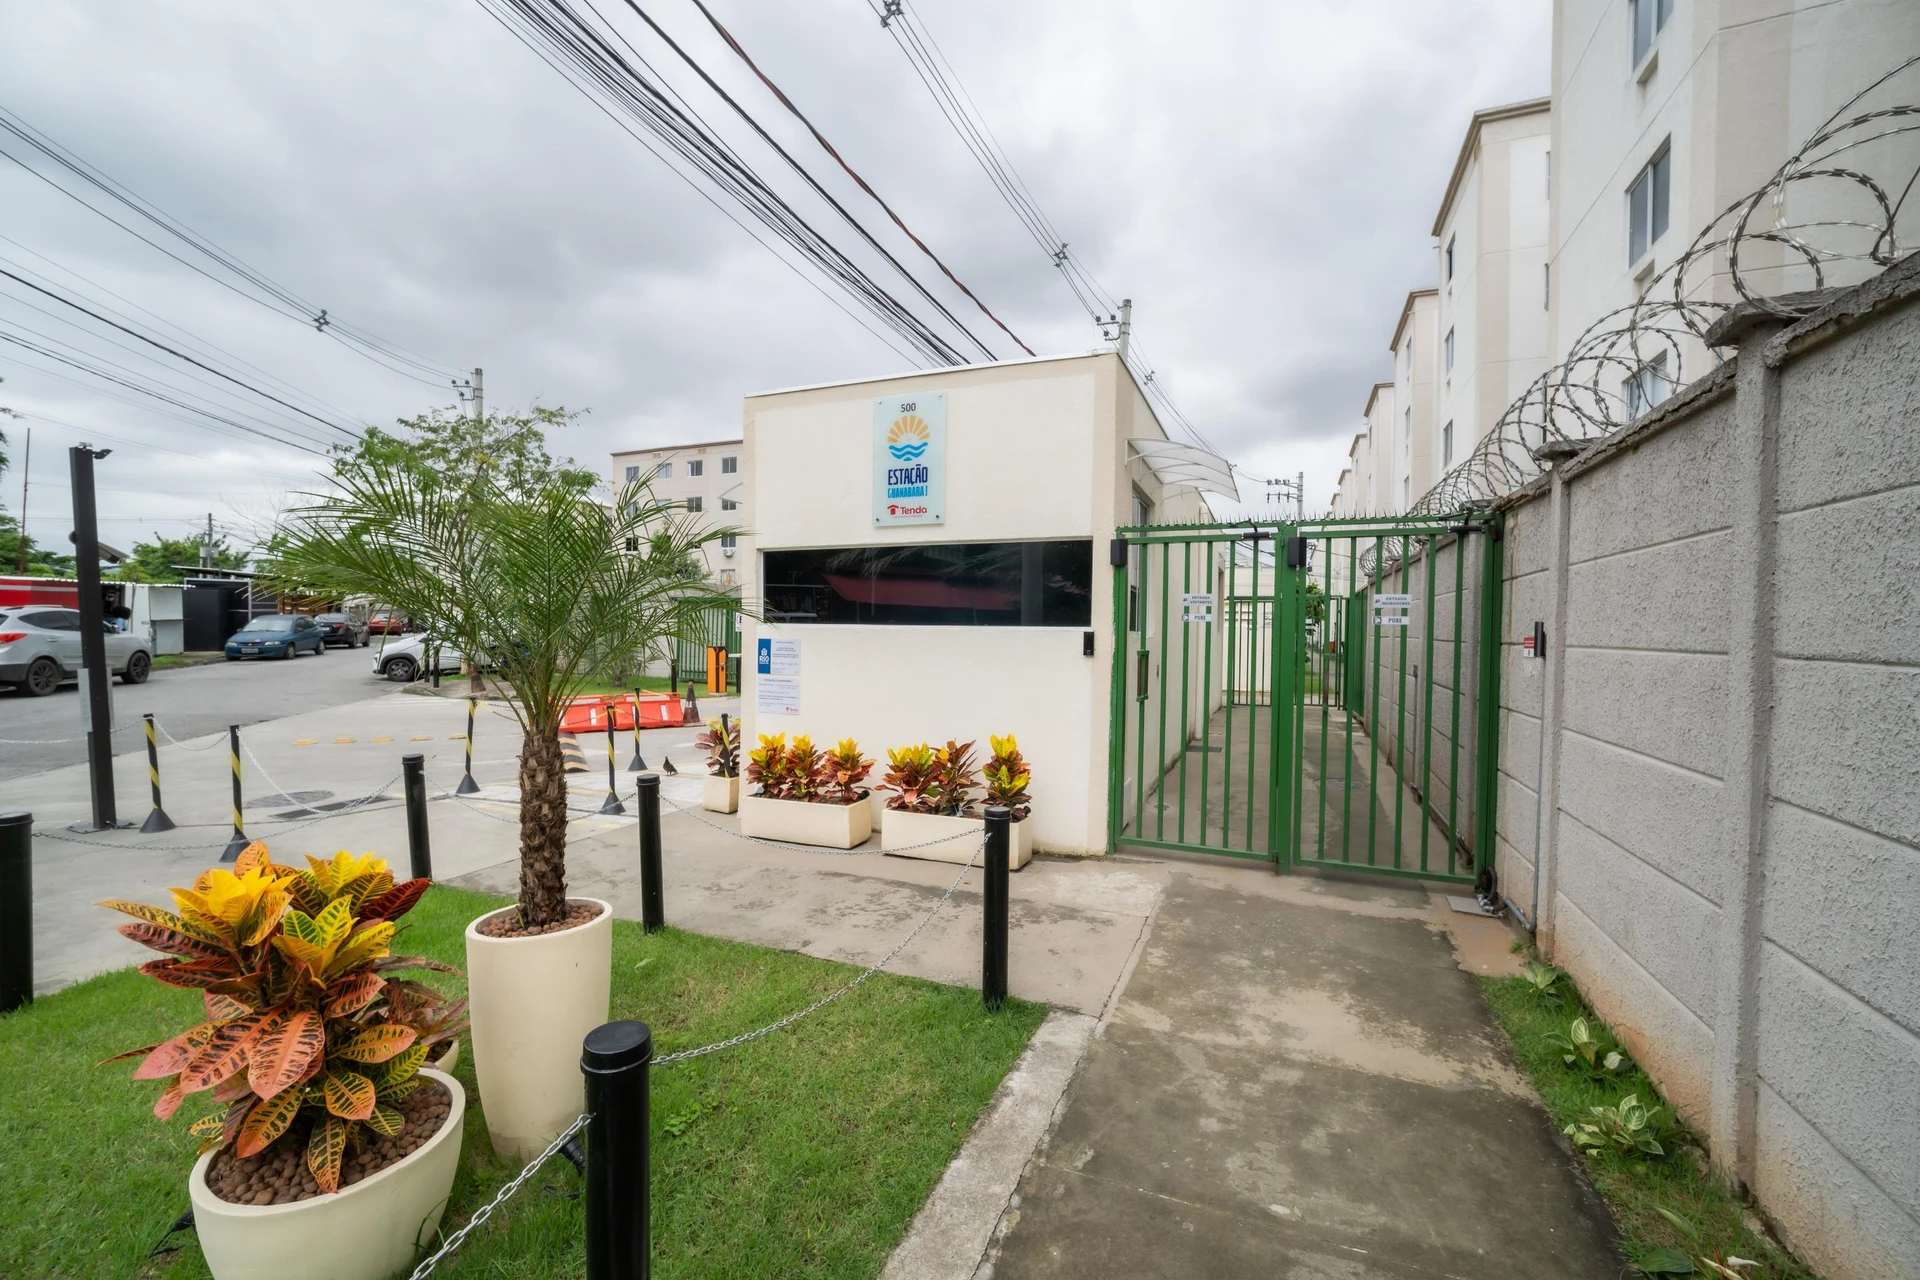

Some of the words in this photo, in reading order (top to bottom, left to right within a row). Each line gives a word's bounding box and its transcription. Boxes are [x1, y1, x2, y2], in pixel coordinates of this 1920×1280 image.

[901, 402, 916, 412] 500
[888, 464, 928, 485] ESTAÇÃO
[887, 486, 924, 498] GUANABARA
[900, 506, 927, 515] Tenda
[759, 655, 769, 663] RIO
